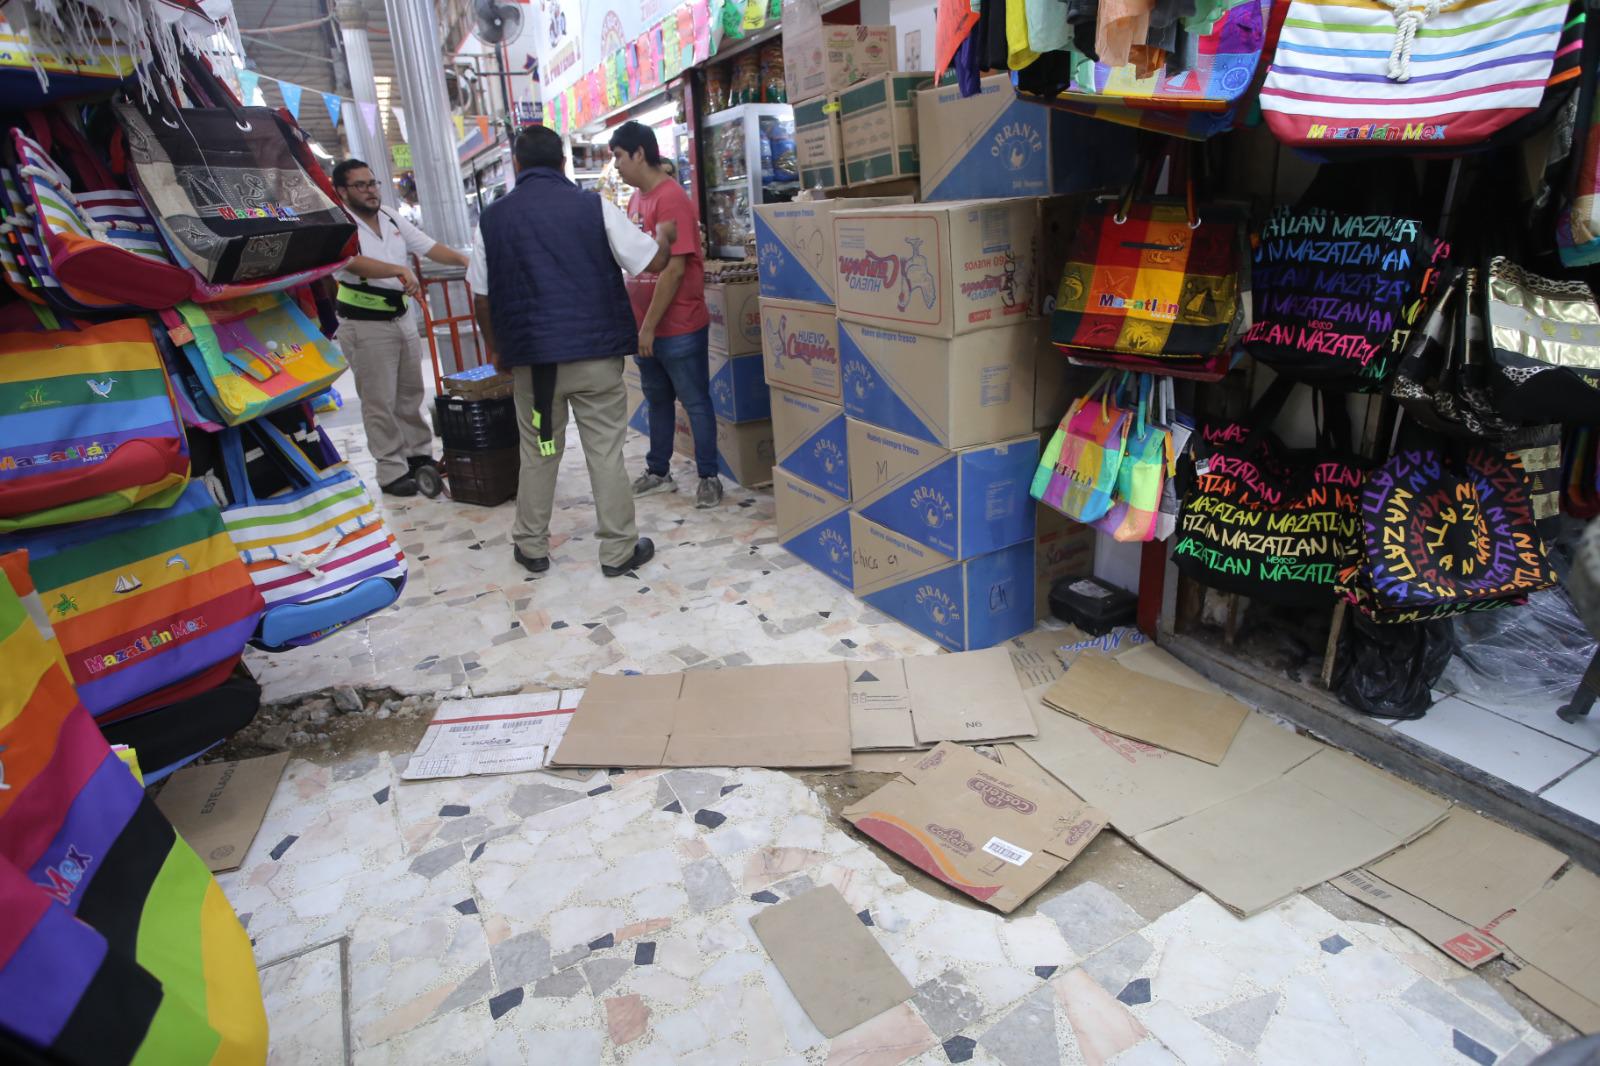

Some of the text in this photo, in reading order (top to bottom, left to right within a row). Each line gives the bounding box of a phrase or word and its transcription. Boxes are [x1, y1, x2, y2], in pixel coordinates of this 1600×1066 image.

[991, 122, 1042, 157] ORRANTE
[1306, 122, 1448, 141] Mazatlán Mex
[849, 276, 882, 293] HUEVO
[1099, 293, 1180, 315] Mazatlán
[798, 329, 825, 344] HUEVO
[910, 486, 954, 521] ORRANTE
[1222, 528, 1328, 557] MAZATLAN
[916, 585, 961, 620] ORRANTE
[84, 616, 208, 674] Mazatlán Mex
[36, 843, 93, 907] Mex
